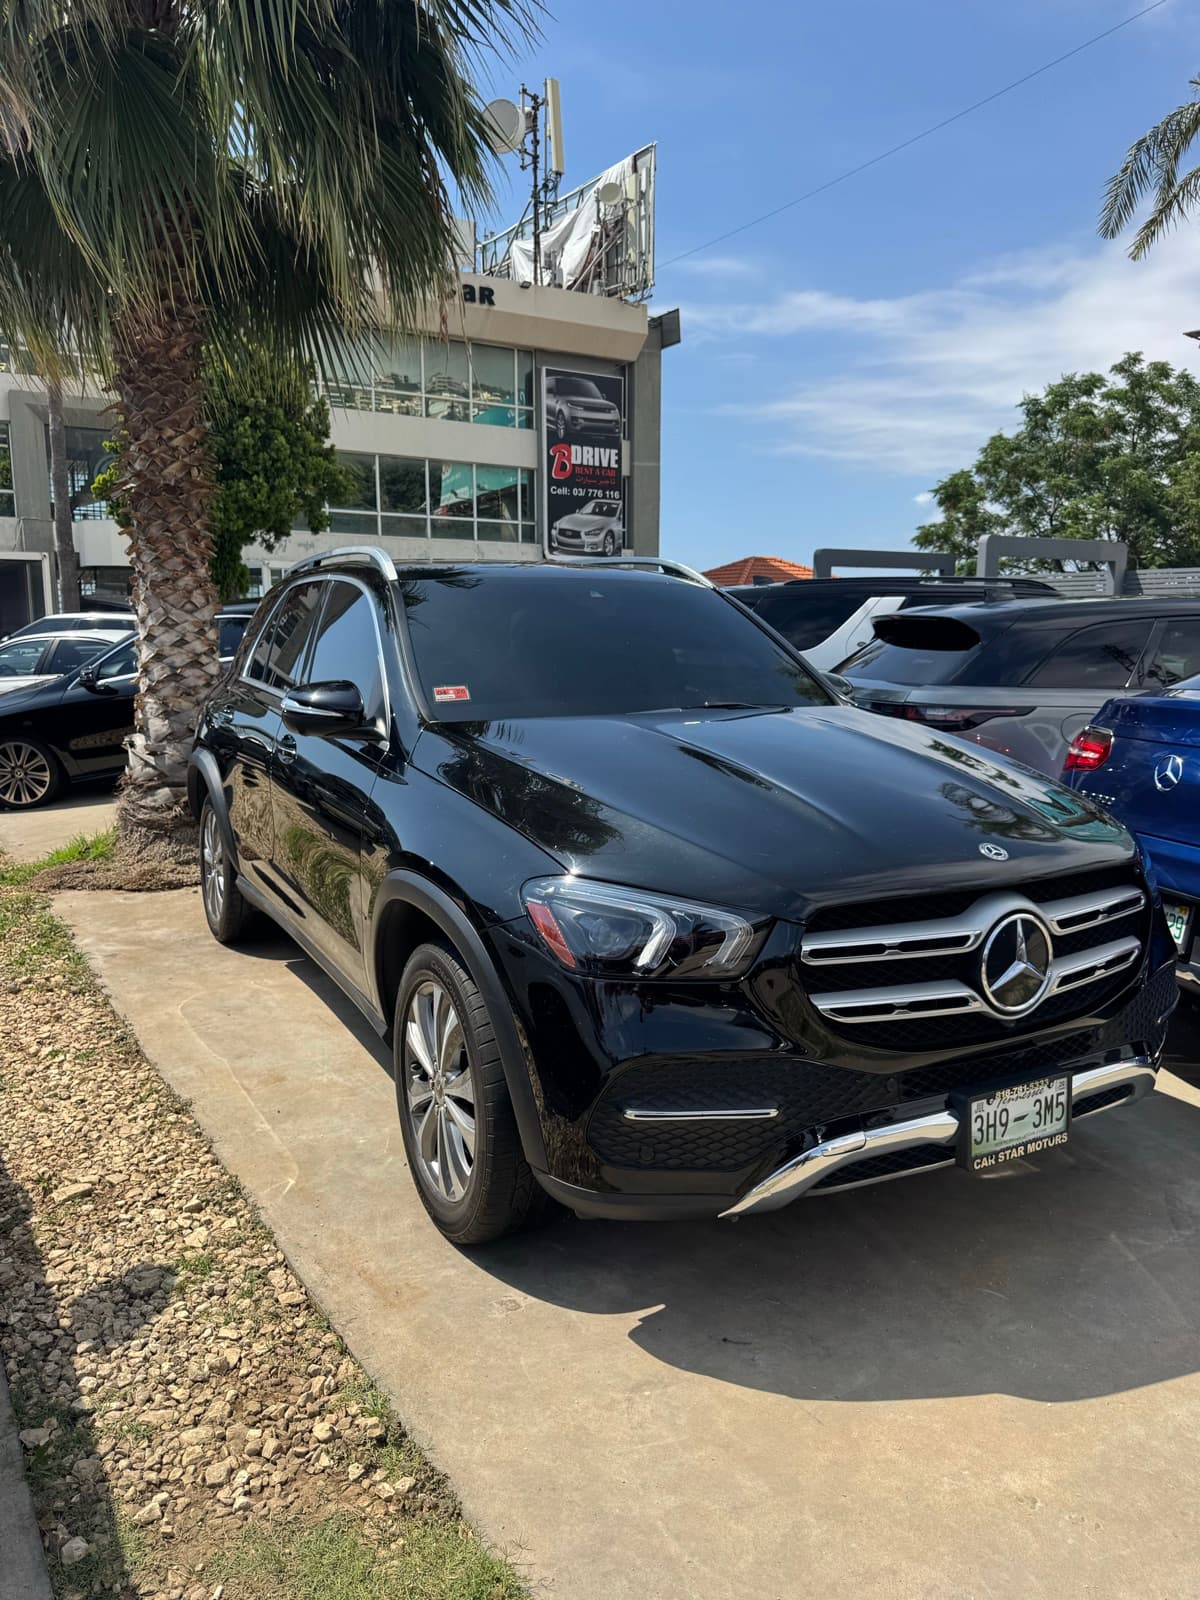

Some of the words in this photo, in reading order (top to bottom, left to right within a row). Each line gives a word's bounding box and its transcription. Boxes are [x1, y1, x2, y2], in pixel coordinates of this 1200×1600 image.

[452, 284, 496, 306] aR
[571, 445, 619, 468] DRIVE
[575, 466, 593, 475] RENT
[602, 469, 616, 477] CAR
[551, 486, 571, 496] Cell:
[974, 1108, 1010, 1146] 3H9
[1032, 1091, 1065, 1129] 3M5
[998, 1145, 1025, 1163] STAR
[1027, 1132, 1068, 1154] MOTORS
